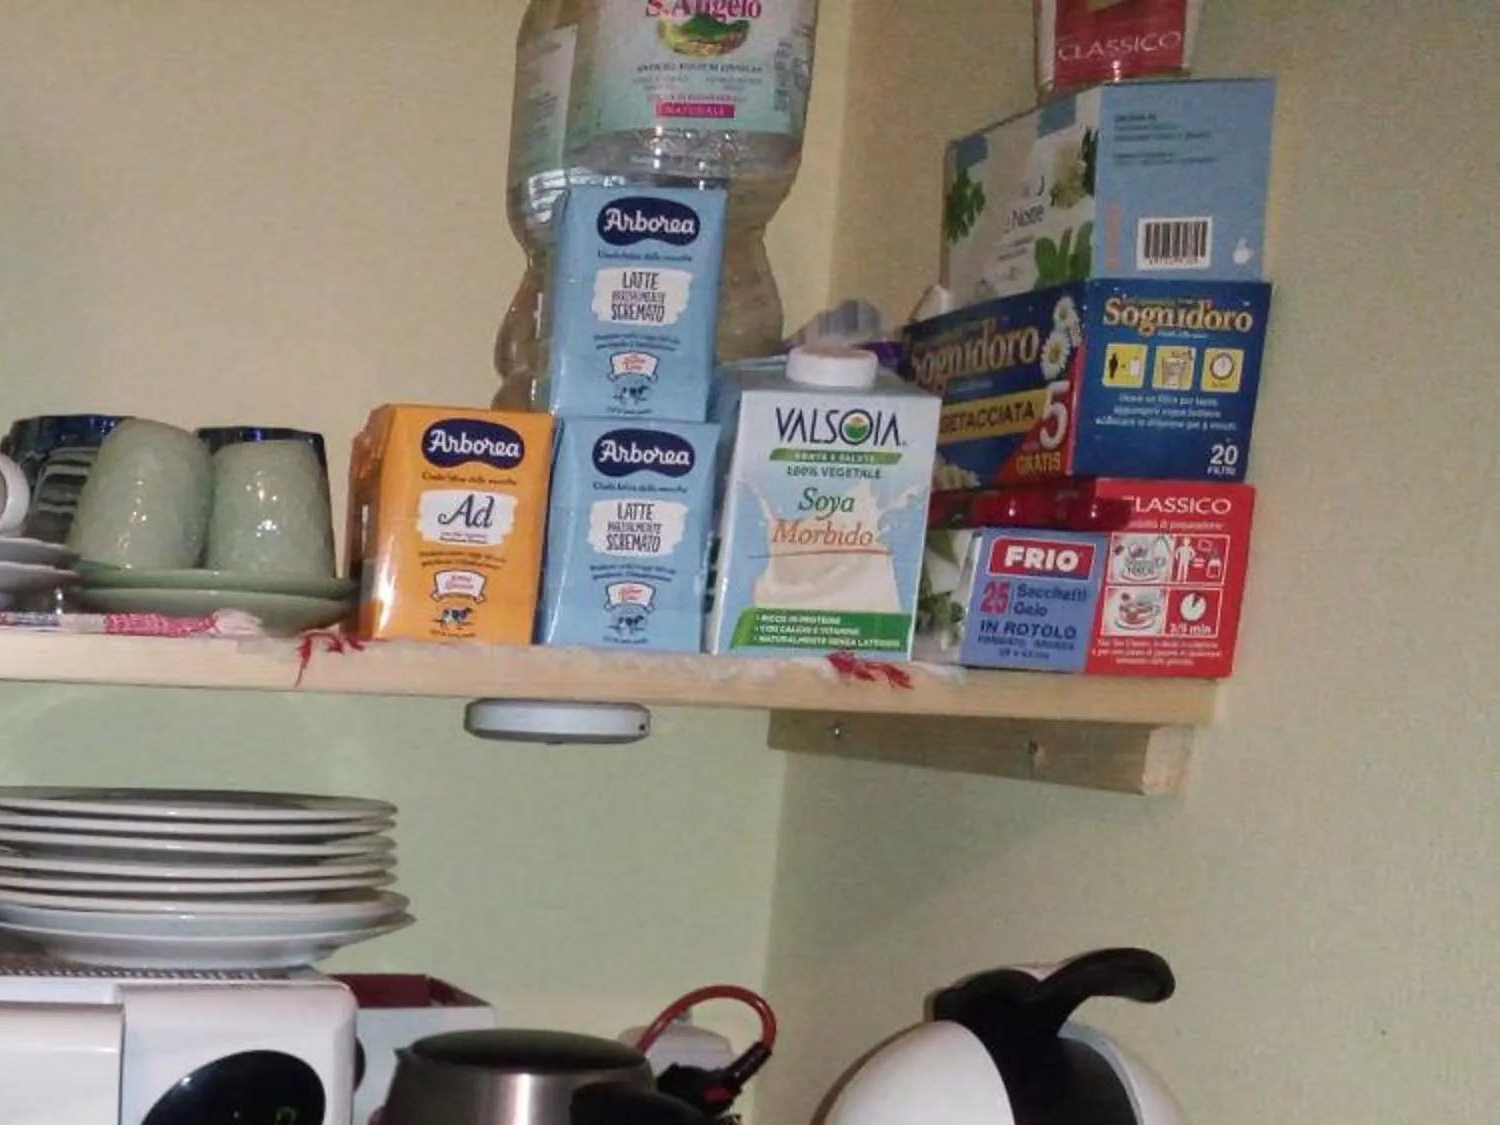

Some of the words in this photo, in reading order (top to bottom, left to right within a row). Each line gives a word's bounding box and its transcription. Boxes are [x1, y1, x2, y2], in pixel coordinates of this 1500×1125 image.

[1057, 30, 1181, 62] CLASSICO
[603, 207, 696, 235] Arborea
[622, 271, 660, 290] LATTE
[775, 406, 901, 447] VALSOIA
[1038, 380, 1072, 450] 5
[427, 428, 521, 458] Arborea
[598, 438, 691, 466] Arborea
[1209, 443, 1239, 466] 20
[1015, 450, 1062, 476] GRATIS
[617, 502, 656, 521] LATTE
[798, 486, 856, 521] Soya
[1123, 495, 1233, 515] LASSICO
[772, 518, 875, 547] Morbido
[1004, 545, 1080, 573] FRIO
[1013, 601, 1048, 617] Gelo
[980, 620, 999, 633] IN
[1002, 620, 1077, 639] ROTOLO
